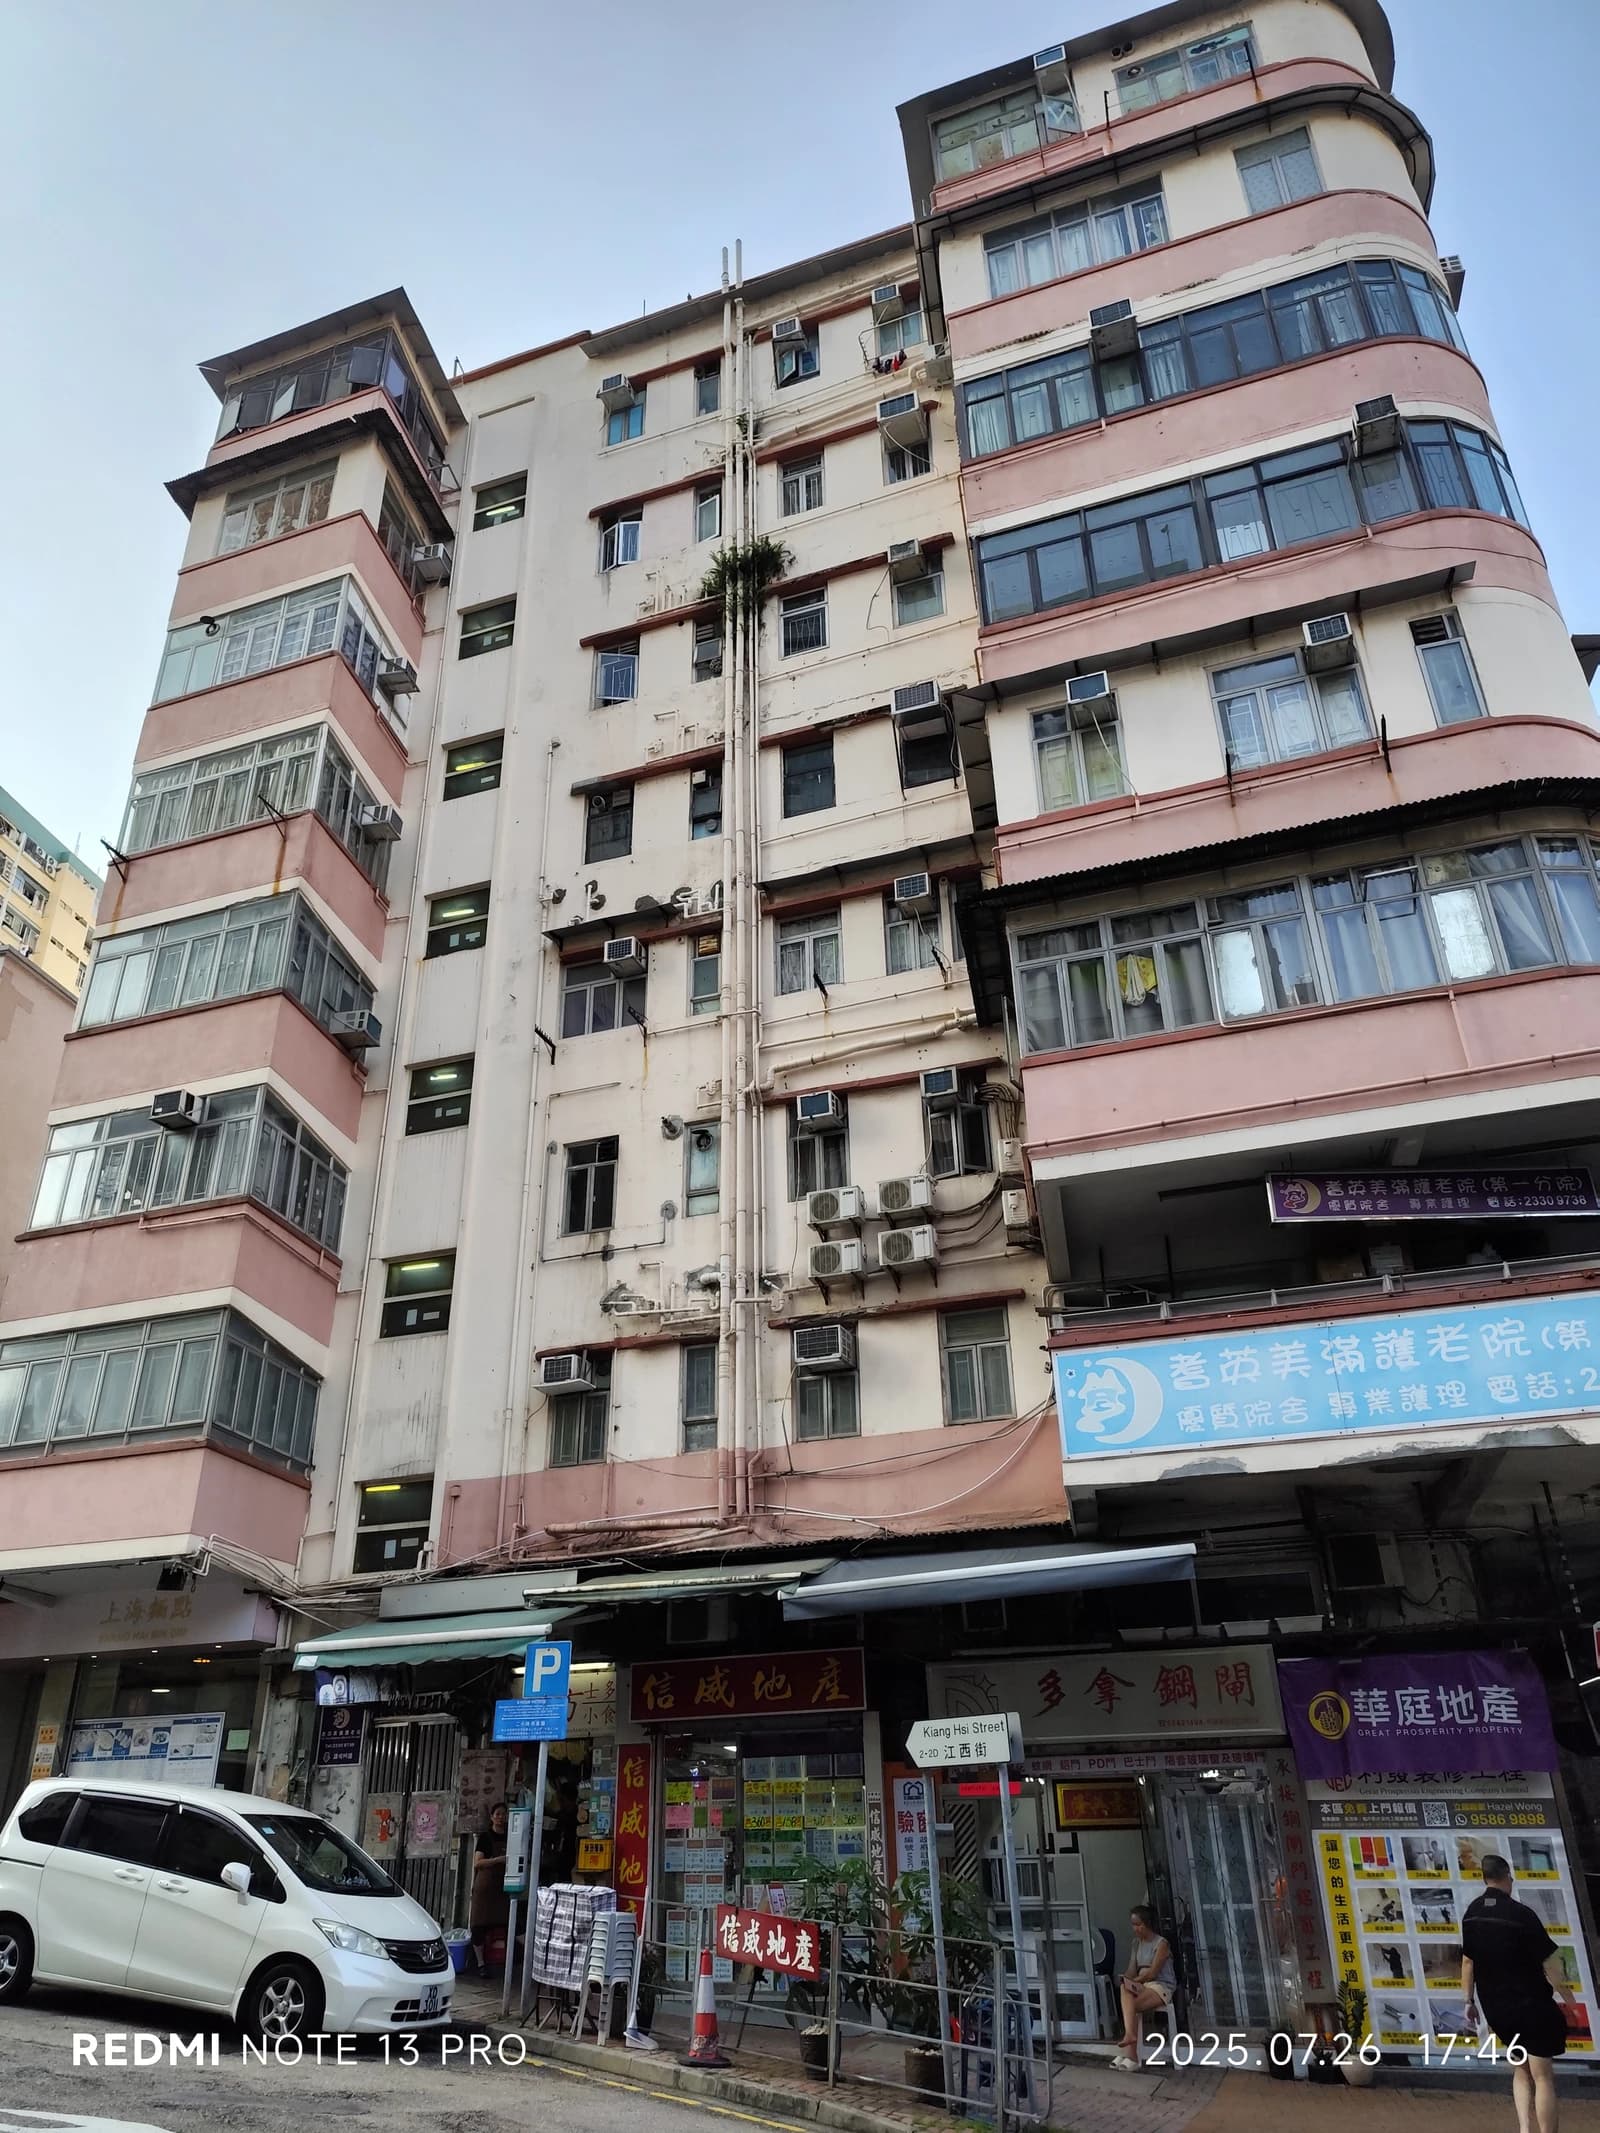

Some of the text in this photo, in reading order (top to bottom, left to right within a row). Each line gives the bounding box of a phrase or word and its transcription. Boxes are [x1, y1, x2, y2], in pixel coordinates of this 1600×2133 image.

[1169, 1319, 1591, 1391] 耆英美滿護老院(第
[1176, 1397, 1311, 1433] 優質院舍
[1329, 1384, 1468, 1420] 專業護理
[532, 1648, 561, 1692] P
[642, 1656, 851, 1711] 信威地產
[1350, 1684, 1523, 1728] 華庭地產
[923, 1719, 1005, 1739] Kiang Hsi Street
[944, 1741, 988, 1759] 江西街
[1358, 1726, 1525, 1737] GREAT PROSPERITY PROPERTY
[1471, 1813, 1546, 1825] 9586 9898
[720, 1915, 815, 1972] 信威地產
